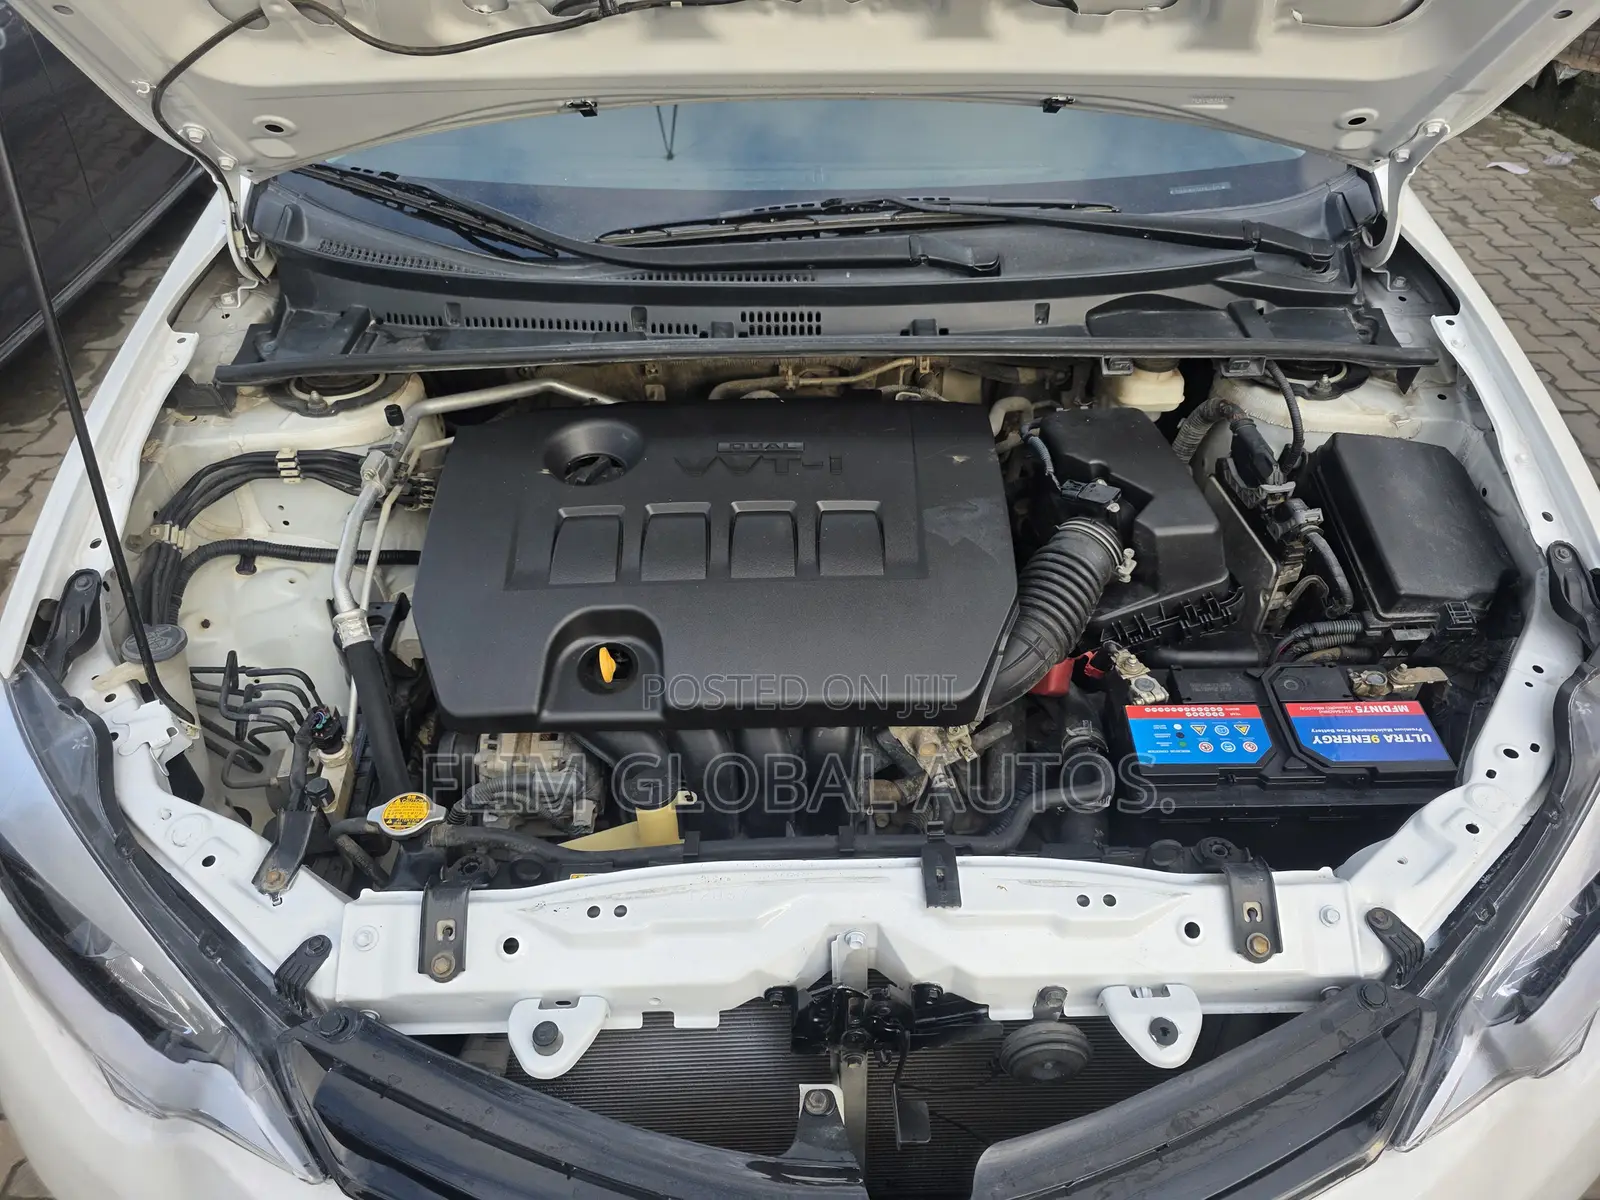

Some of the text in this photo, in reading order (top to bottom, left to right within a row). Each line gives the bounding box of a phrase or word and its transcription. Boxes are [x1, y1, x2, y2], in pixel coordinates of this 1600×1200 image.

[728, 442, 800, 451] DUAL
[1355, 705, 1410, 713] MFDIN75
[1312, 734, 1433, 744] ULTRA 9ENERGY
